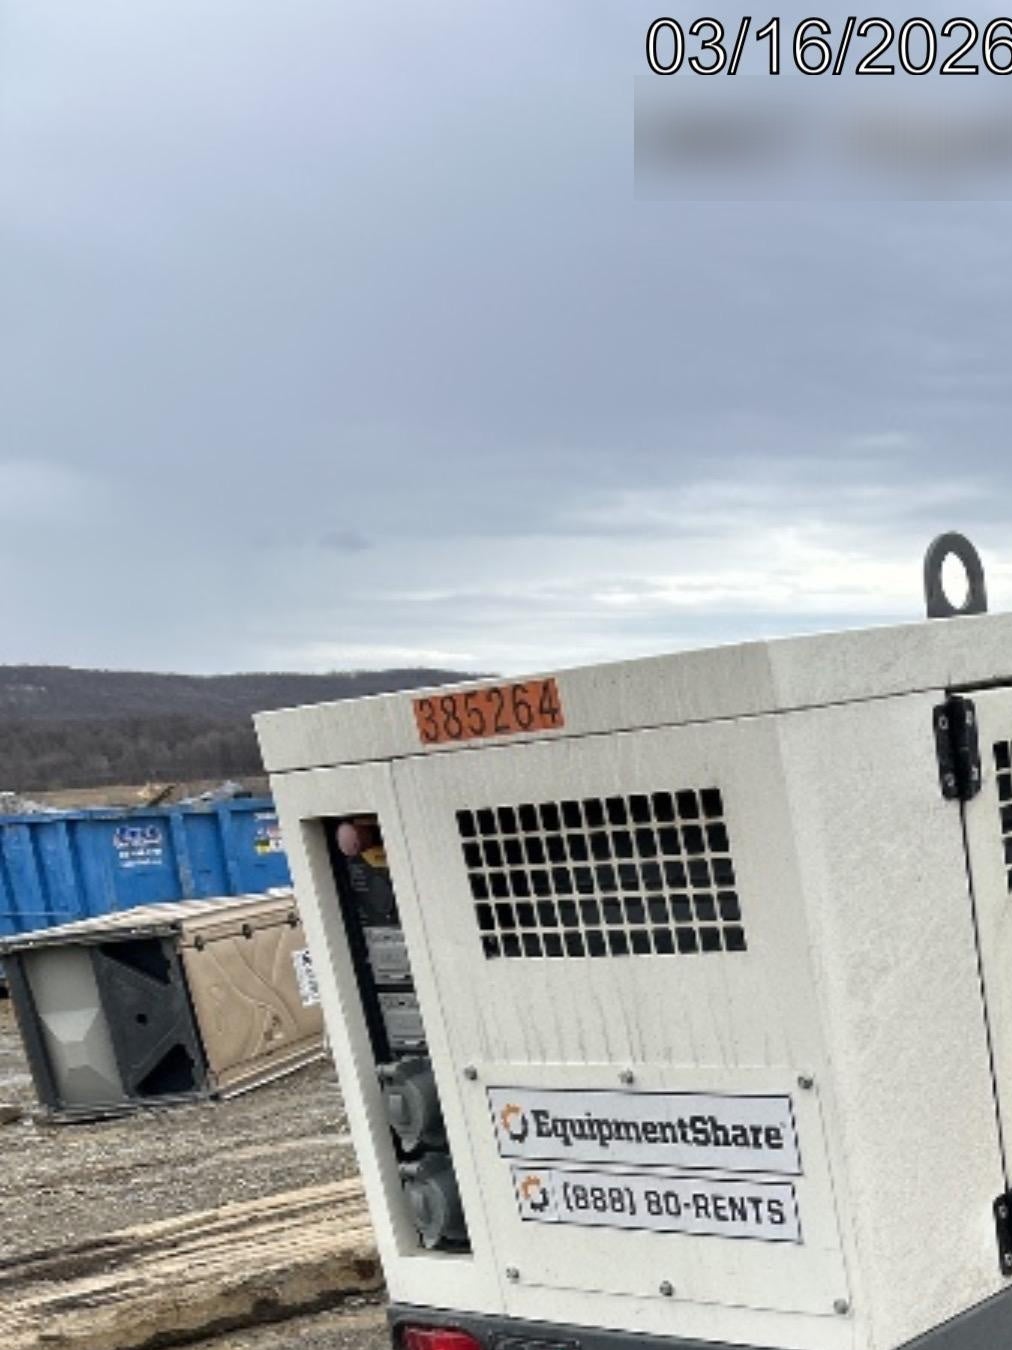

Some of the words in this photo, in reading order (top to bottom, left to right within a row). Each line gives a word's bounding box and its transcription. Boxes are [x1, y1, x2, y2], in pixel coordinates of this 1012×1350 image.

[418, 678, 560, 741] 385264
[530, 1109, 784, 1149] EquipmentShare
[562, 1182, 636, 1216] (888)
[644, 1190, 786, 1225] 80-RENTS
